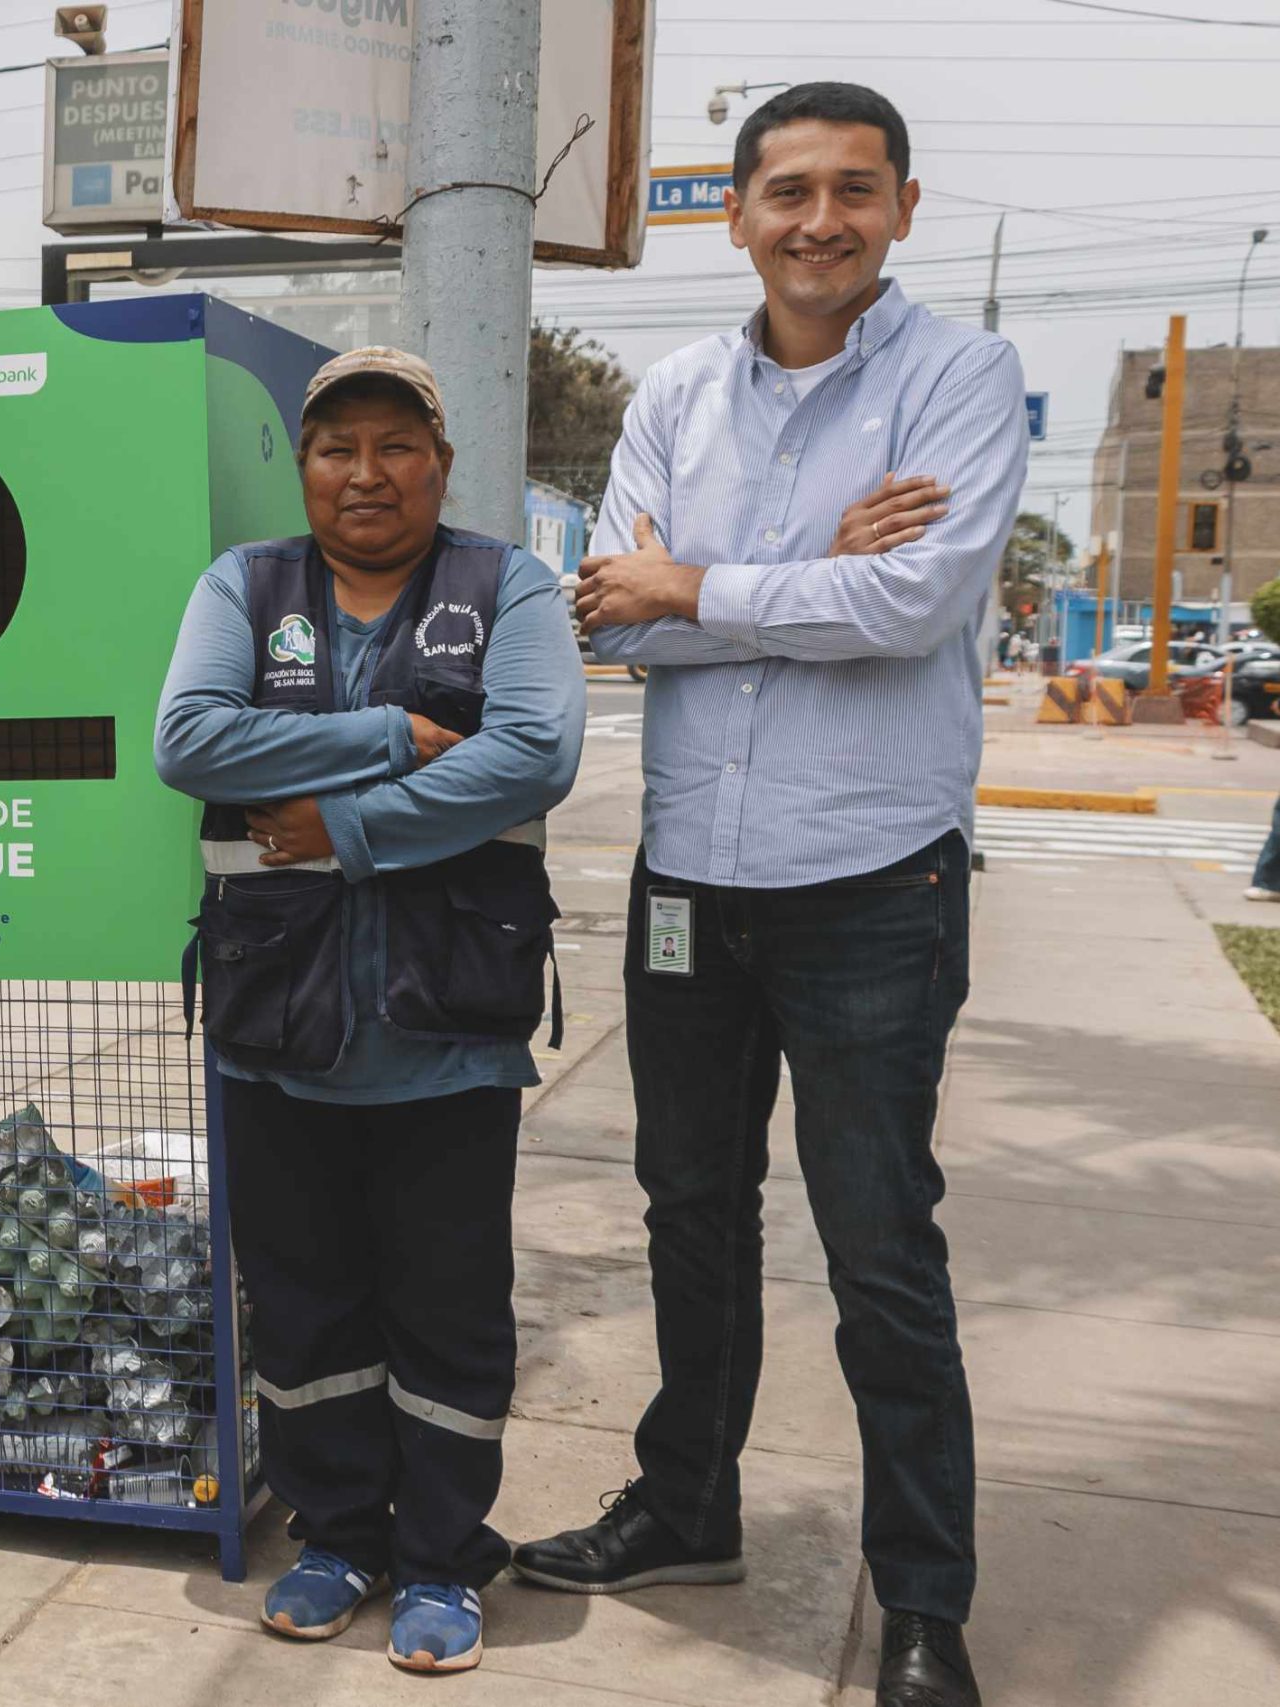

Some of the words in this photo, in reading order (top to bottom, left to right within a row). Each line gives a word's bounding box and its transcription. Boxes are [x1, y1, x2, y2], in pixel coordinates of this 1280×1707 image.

[72, 74, 159, 99] PUNTO
[64, 101, 165, 126] DESPUES
[126, 170, 164, 195] Pa
[656, 183, 682, 206] La
[448, 603, 461, 613] EN
[460, 604, 472, 614] LA
[423, 643, 446, 657] SAN
